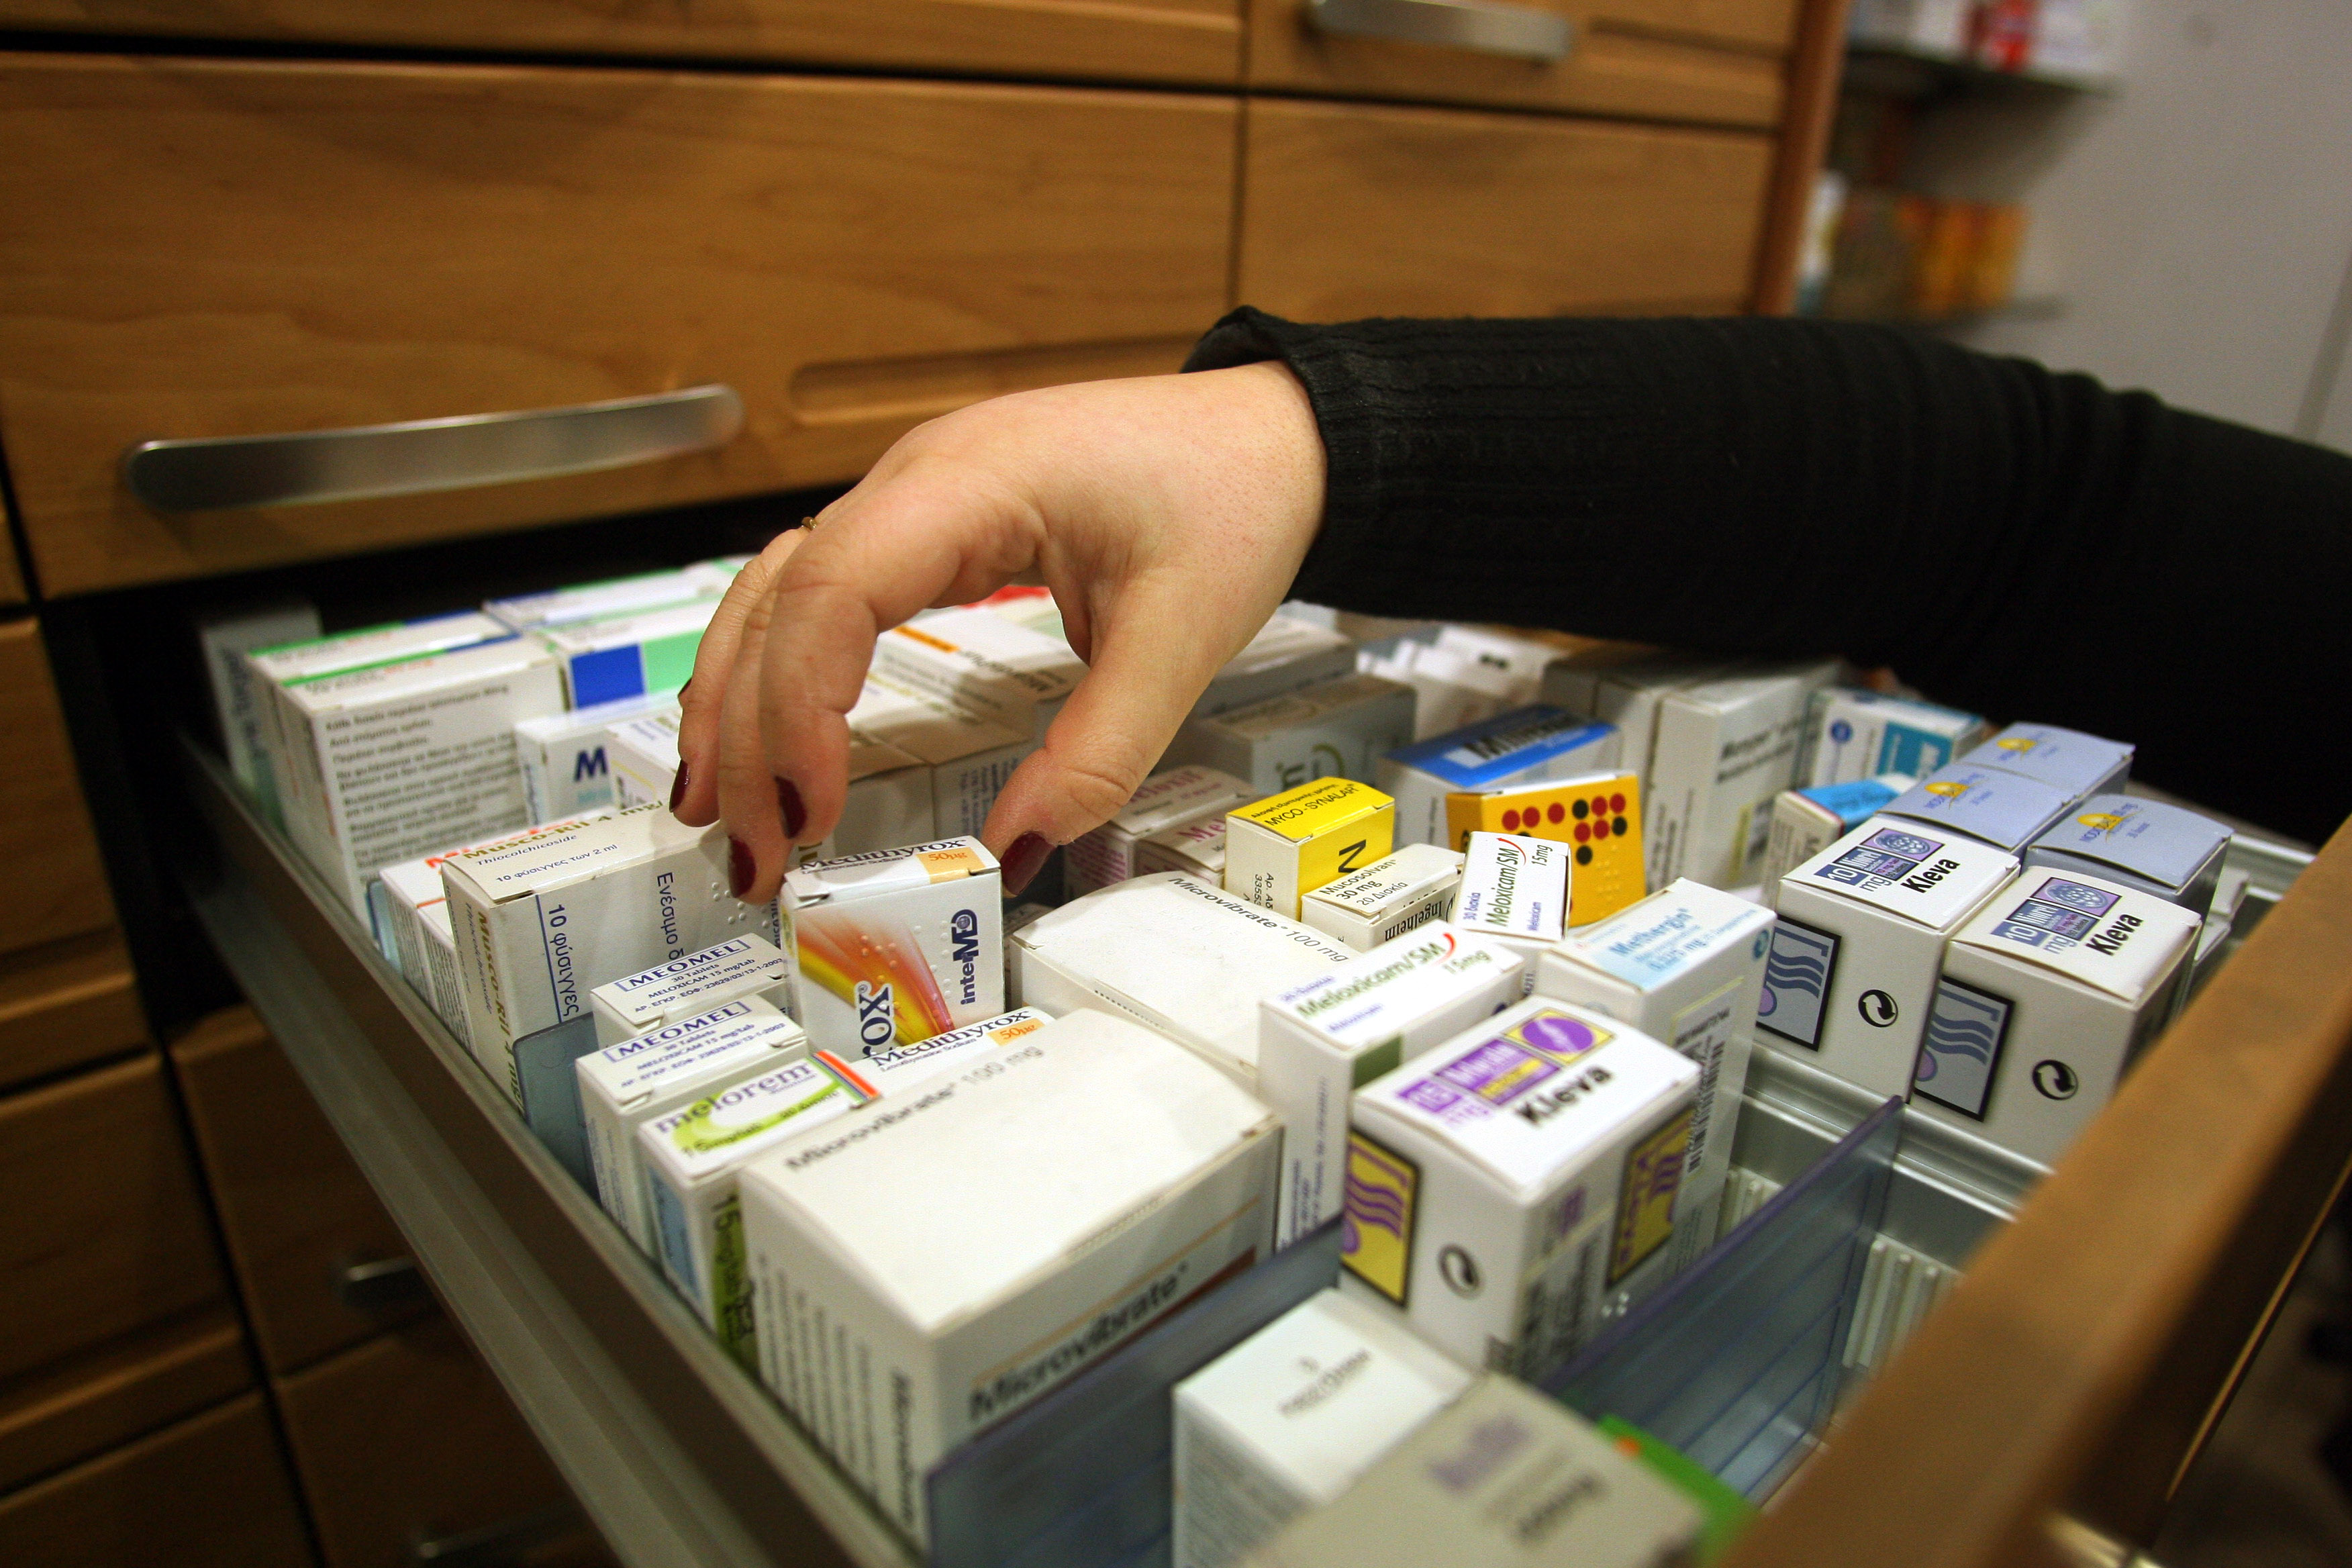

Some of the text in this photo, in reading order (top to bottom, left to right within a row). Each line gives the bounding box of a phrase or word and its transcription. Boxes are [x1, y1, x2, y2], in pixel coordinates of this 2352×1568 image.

[463, 821, 591, 859] Musco-Ril
[477, 834, 578, 866] Thiocolchicoside
[800, 839, 967, 871] Medithyrox
[496, 874, 512, 883] 10
[514, 859, 569, 879] φύσιγγες
[569, 851, 591, 863] των
[603, 843, 618, 854] ml
[1319, 861, 1394, 895] Mucosolvan
[1826, 867, 1894, 893] 10 mg
[1900, 859, 1961, 894] Kleva
[1336, 879, 1383, 901] 30 mg
[1356, 895, 1375, 906] 20
[1485, 844, 1553, 928] Meloxicam/SM 15mg
[657, 871, 679, 945] Ενέσιμο
[1168, 877, 1278, 929] Microvibrate
[1286, 930, 1321, 948] 100
[1318, 947, 1349, 963] mg
[1384, 899, 1442, 942] Ingelheim
[2004, 925, 2079, 955] 10 mg
[2086, 913, 2144, 957] Kleva
[477, 910, 511, 1037] Musco-Ril
[548, 903, 580, 1017] 10 φύσιγγες
[628, 941, 741, 987] MEOMEL
[648, 958, 756, 999] MELOXICAM 15 mg/tab
[671, 963, 720, 983] 30 Tablets
[618, 1006, 740, 1057] MEOMEL
[873, 1010, 1032, 1067] Medithyrox
[656, 1063, 812, 1134] melorem
[1515, 1065, 1612, 1126] Kleva
